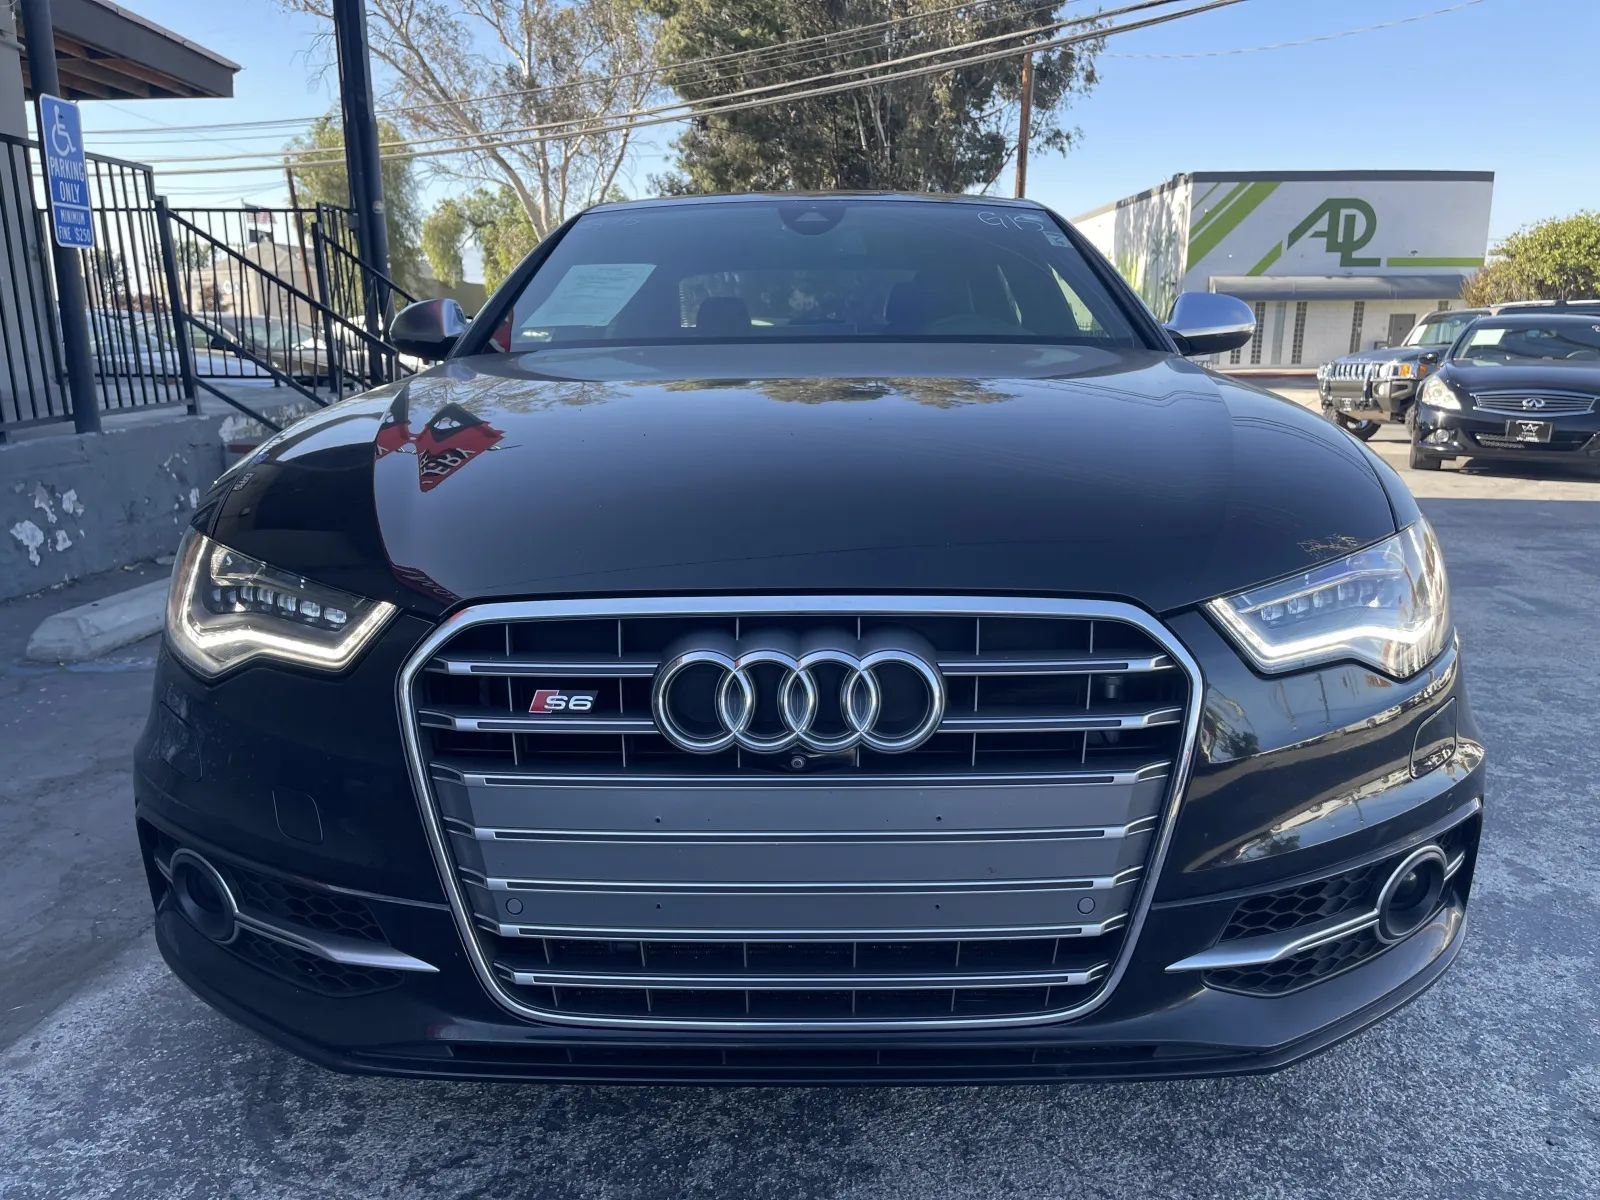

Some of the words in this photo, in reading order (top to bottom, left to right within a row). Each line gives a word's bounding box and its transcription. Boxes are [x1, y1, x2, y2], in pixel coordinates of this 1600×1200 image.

[50, 157, 85, 182] PARKING
[59, 182, 80, 203] ONLY
[60, 208, 86, 225] MINIMUM
[58, 225, 71, 241] FINE
[75, 226, 91, 242] $250
[543, 695, 594, 711] S6
